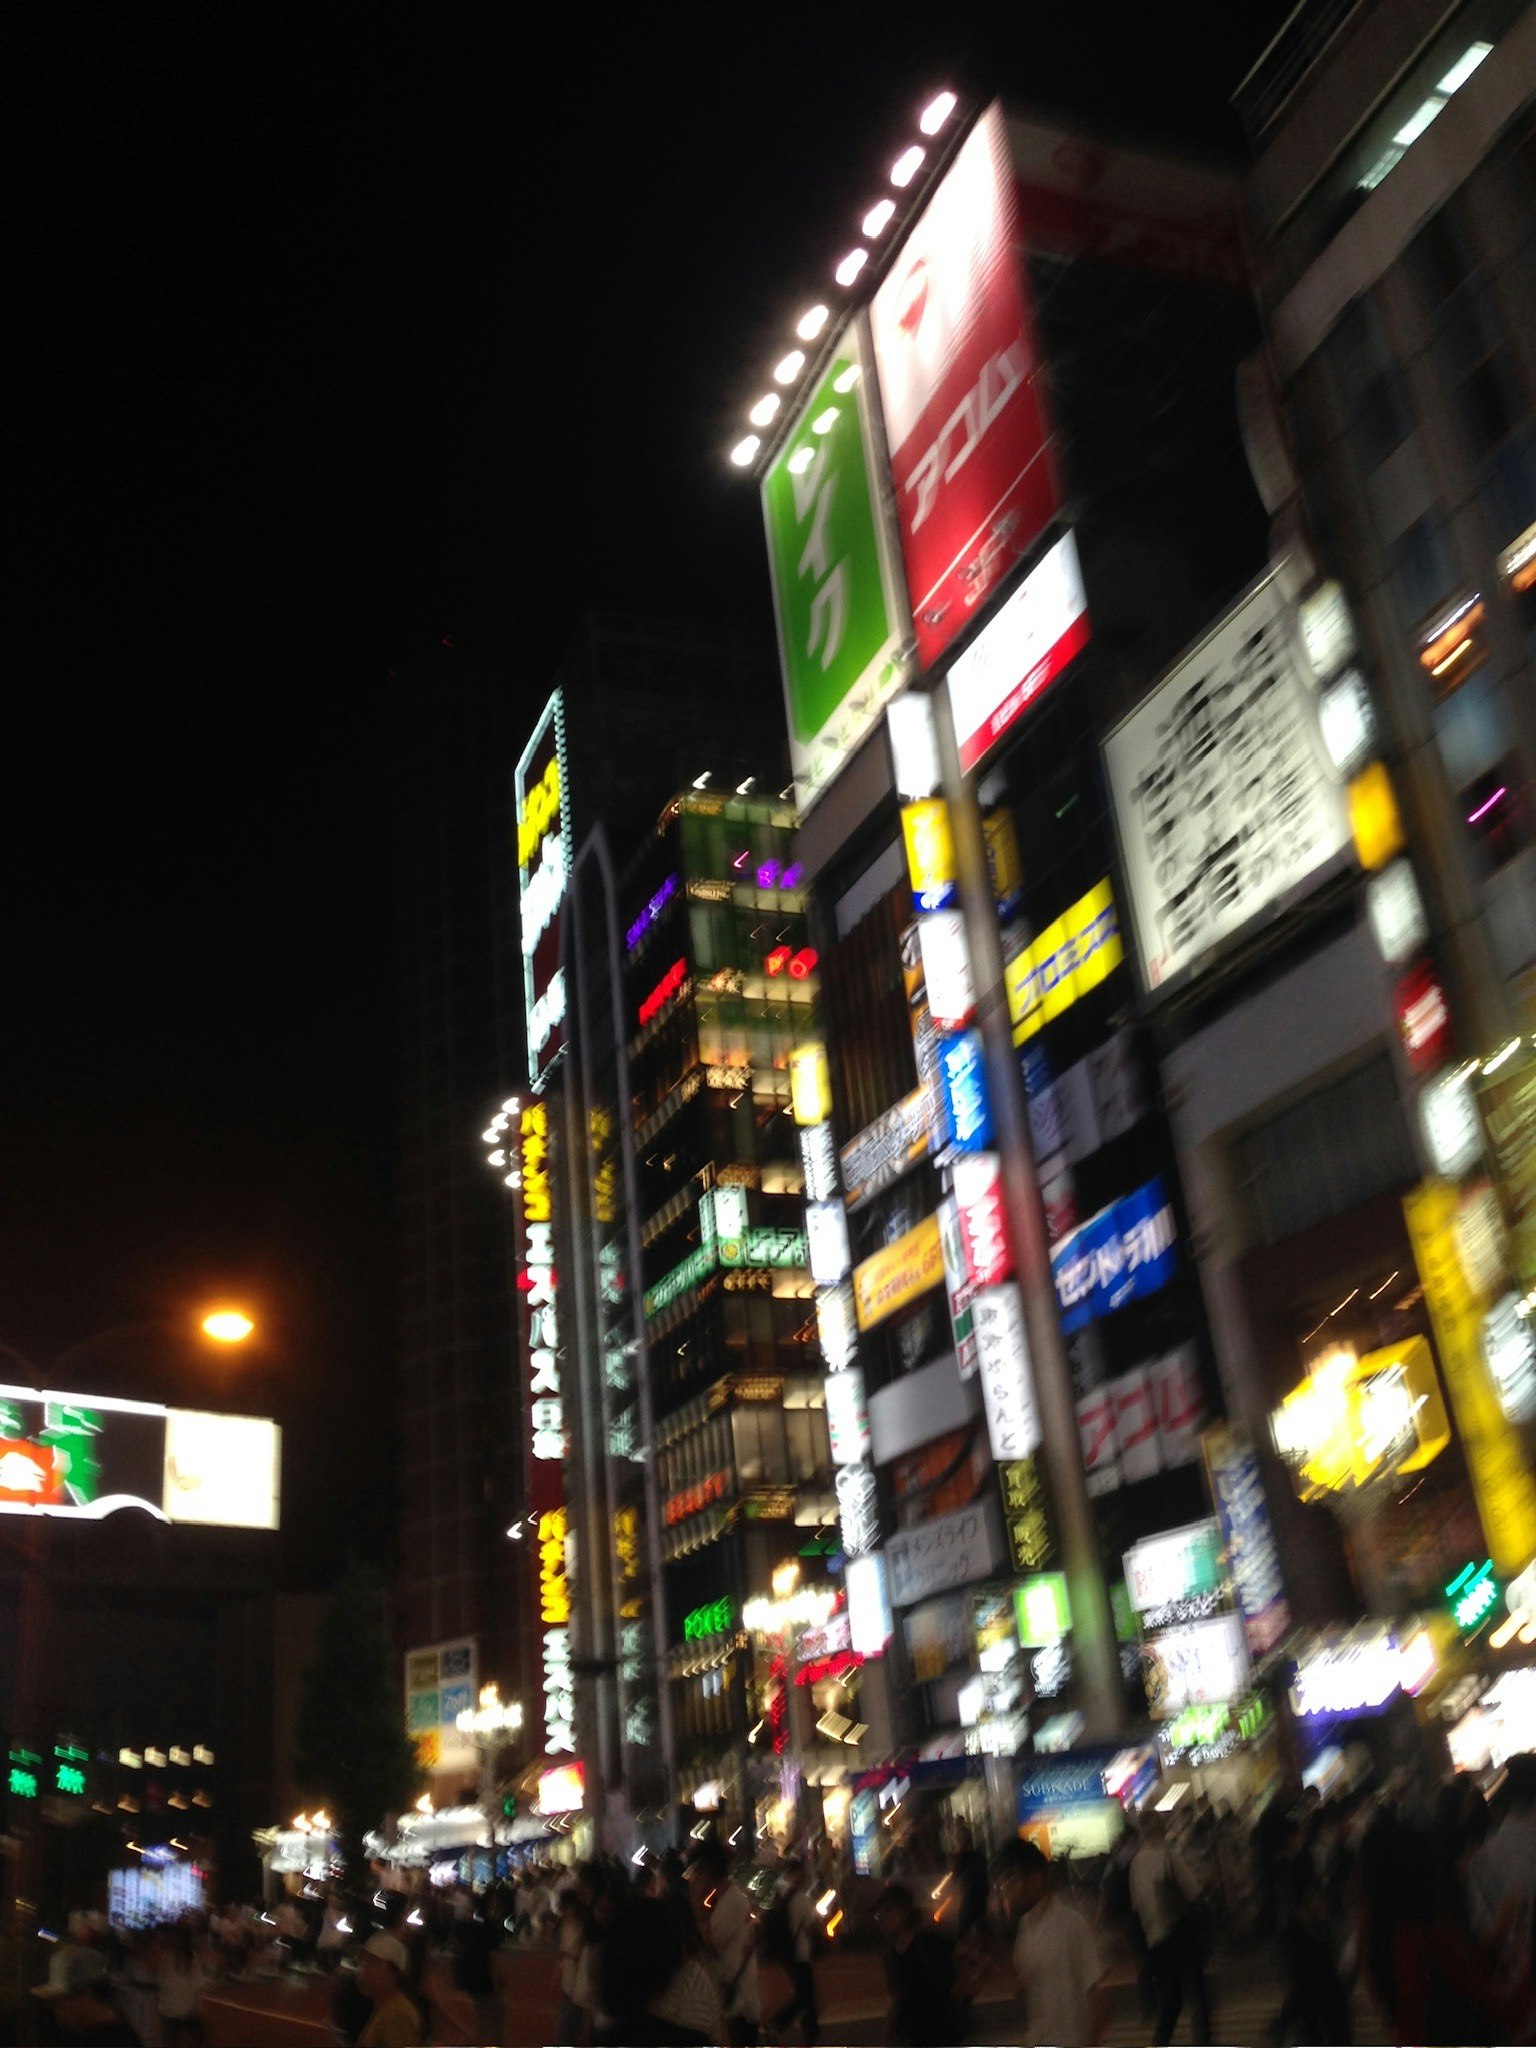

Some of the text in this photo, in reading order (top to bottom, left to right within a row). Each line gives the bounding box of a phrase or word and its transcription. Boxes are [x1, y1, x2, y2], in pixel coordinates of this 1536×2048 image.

[905, 337, 1036, 534] アコム
[1015, 906, 1121, 1014] プロミス
